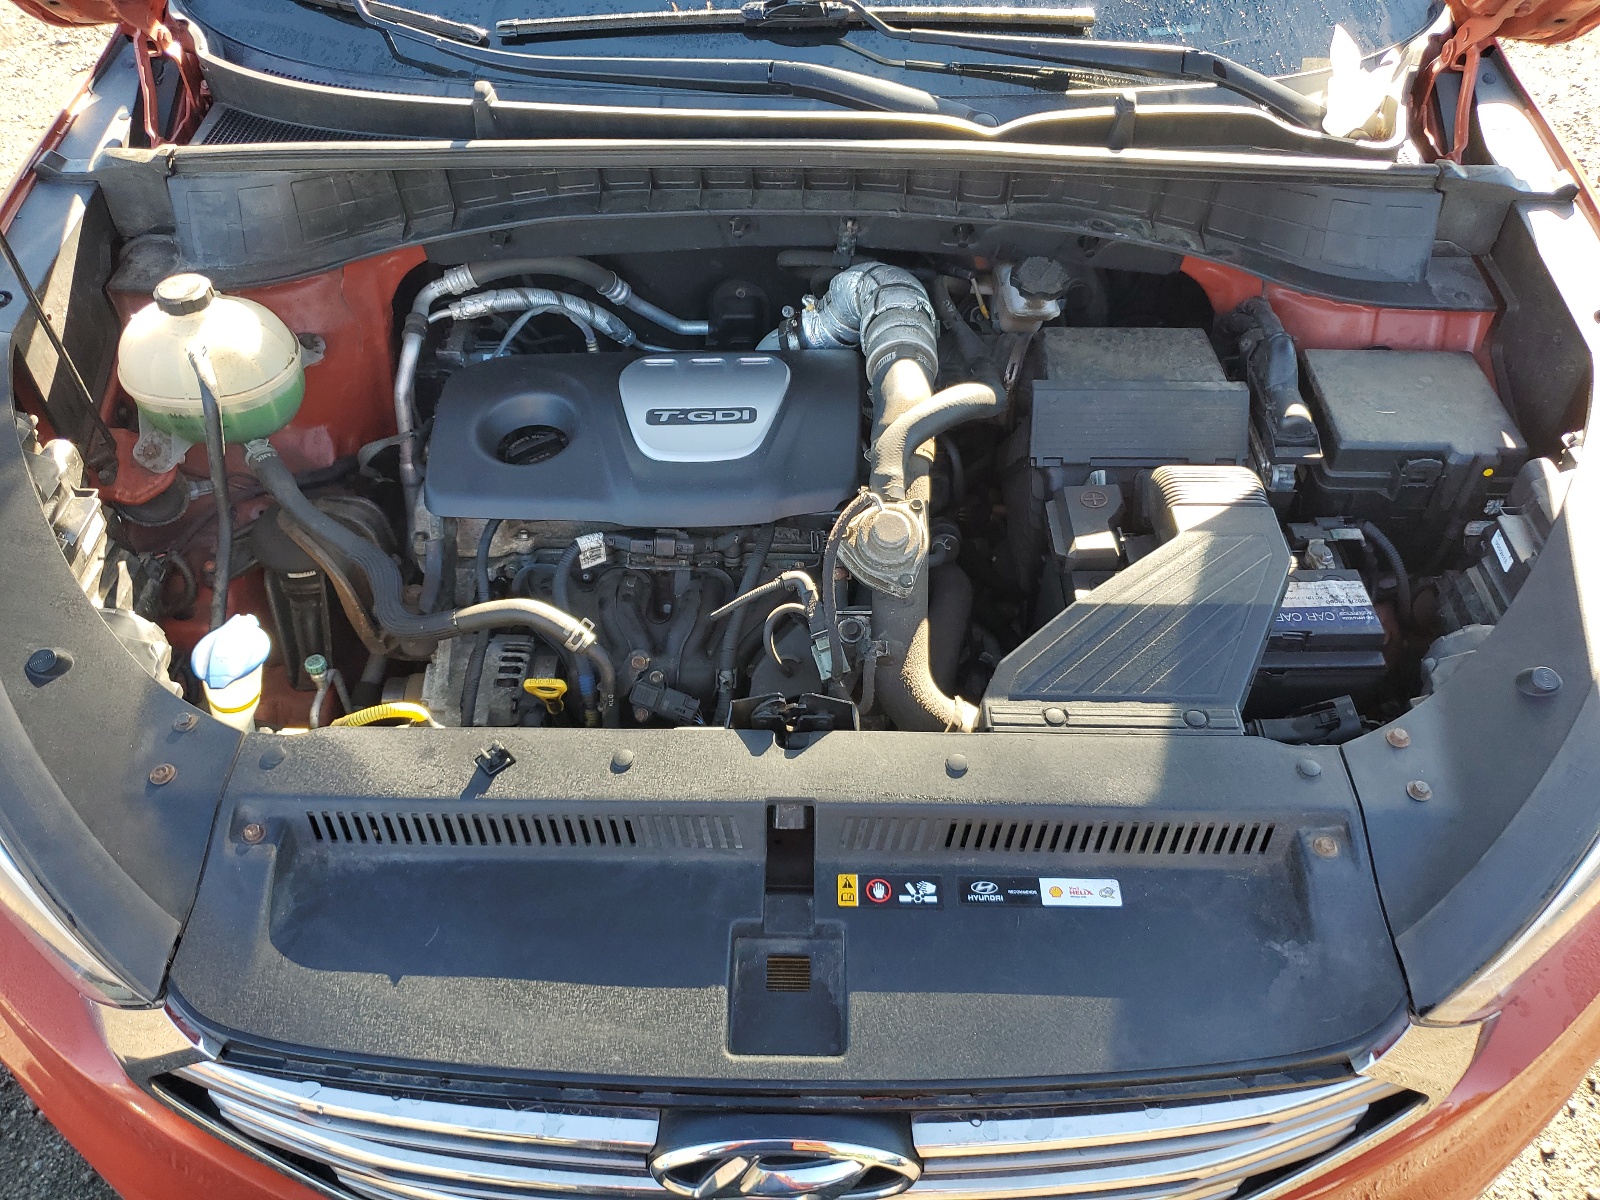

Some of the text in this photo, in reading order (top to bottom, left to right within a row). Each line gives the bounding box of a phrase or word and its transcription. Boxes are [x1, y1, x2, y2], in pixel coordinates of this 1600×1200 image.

[653, 409, 750, 422] T-GDI
[1305, 612, 1335, 621] CAR
[967, 894, 1003, 902] HYUNDAI
